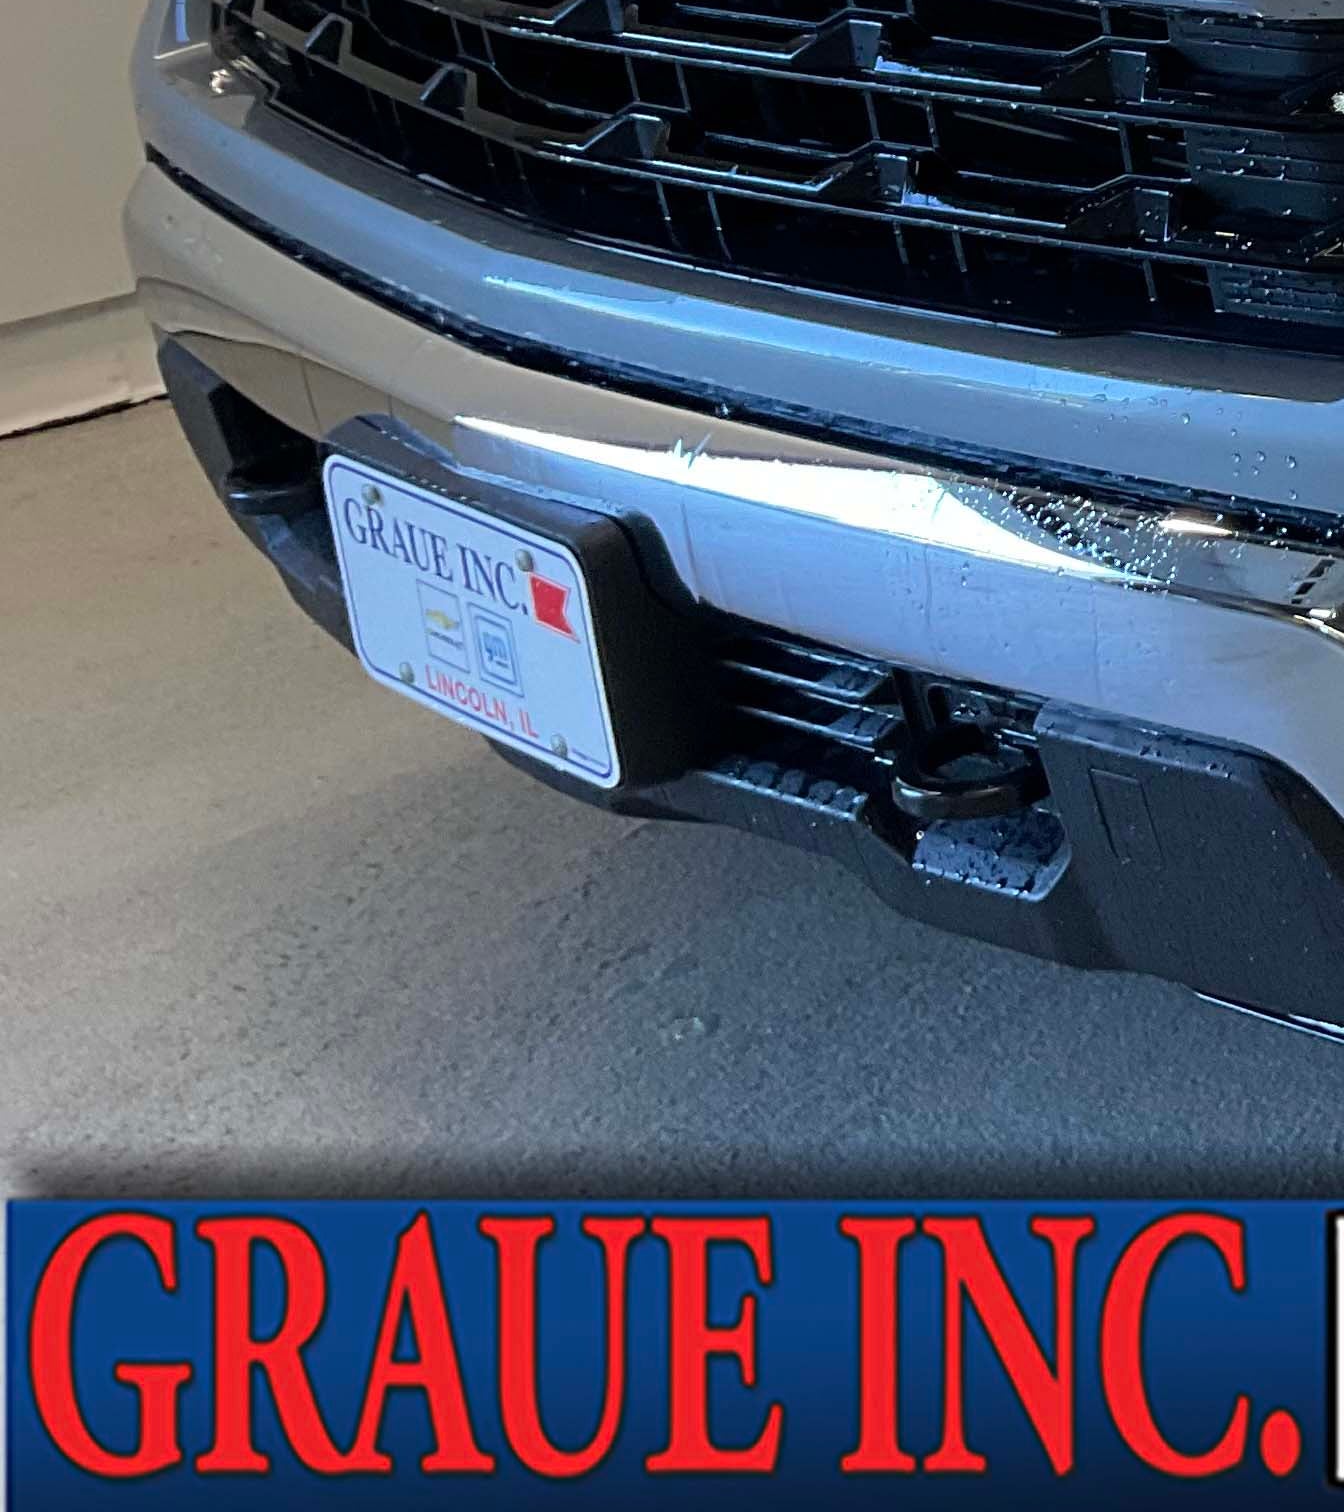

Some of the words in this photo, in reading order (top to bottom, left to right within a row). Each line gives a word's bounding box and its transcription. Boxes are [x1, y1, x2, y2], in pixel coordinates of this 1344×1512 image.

[345, 498, 453, 582] GRAUE
[457, 544, 528, 615] INC.
[425, 666, 514, 730] LINCOLN,
[520, 711, 540, 738] IL
